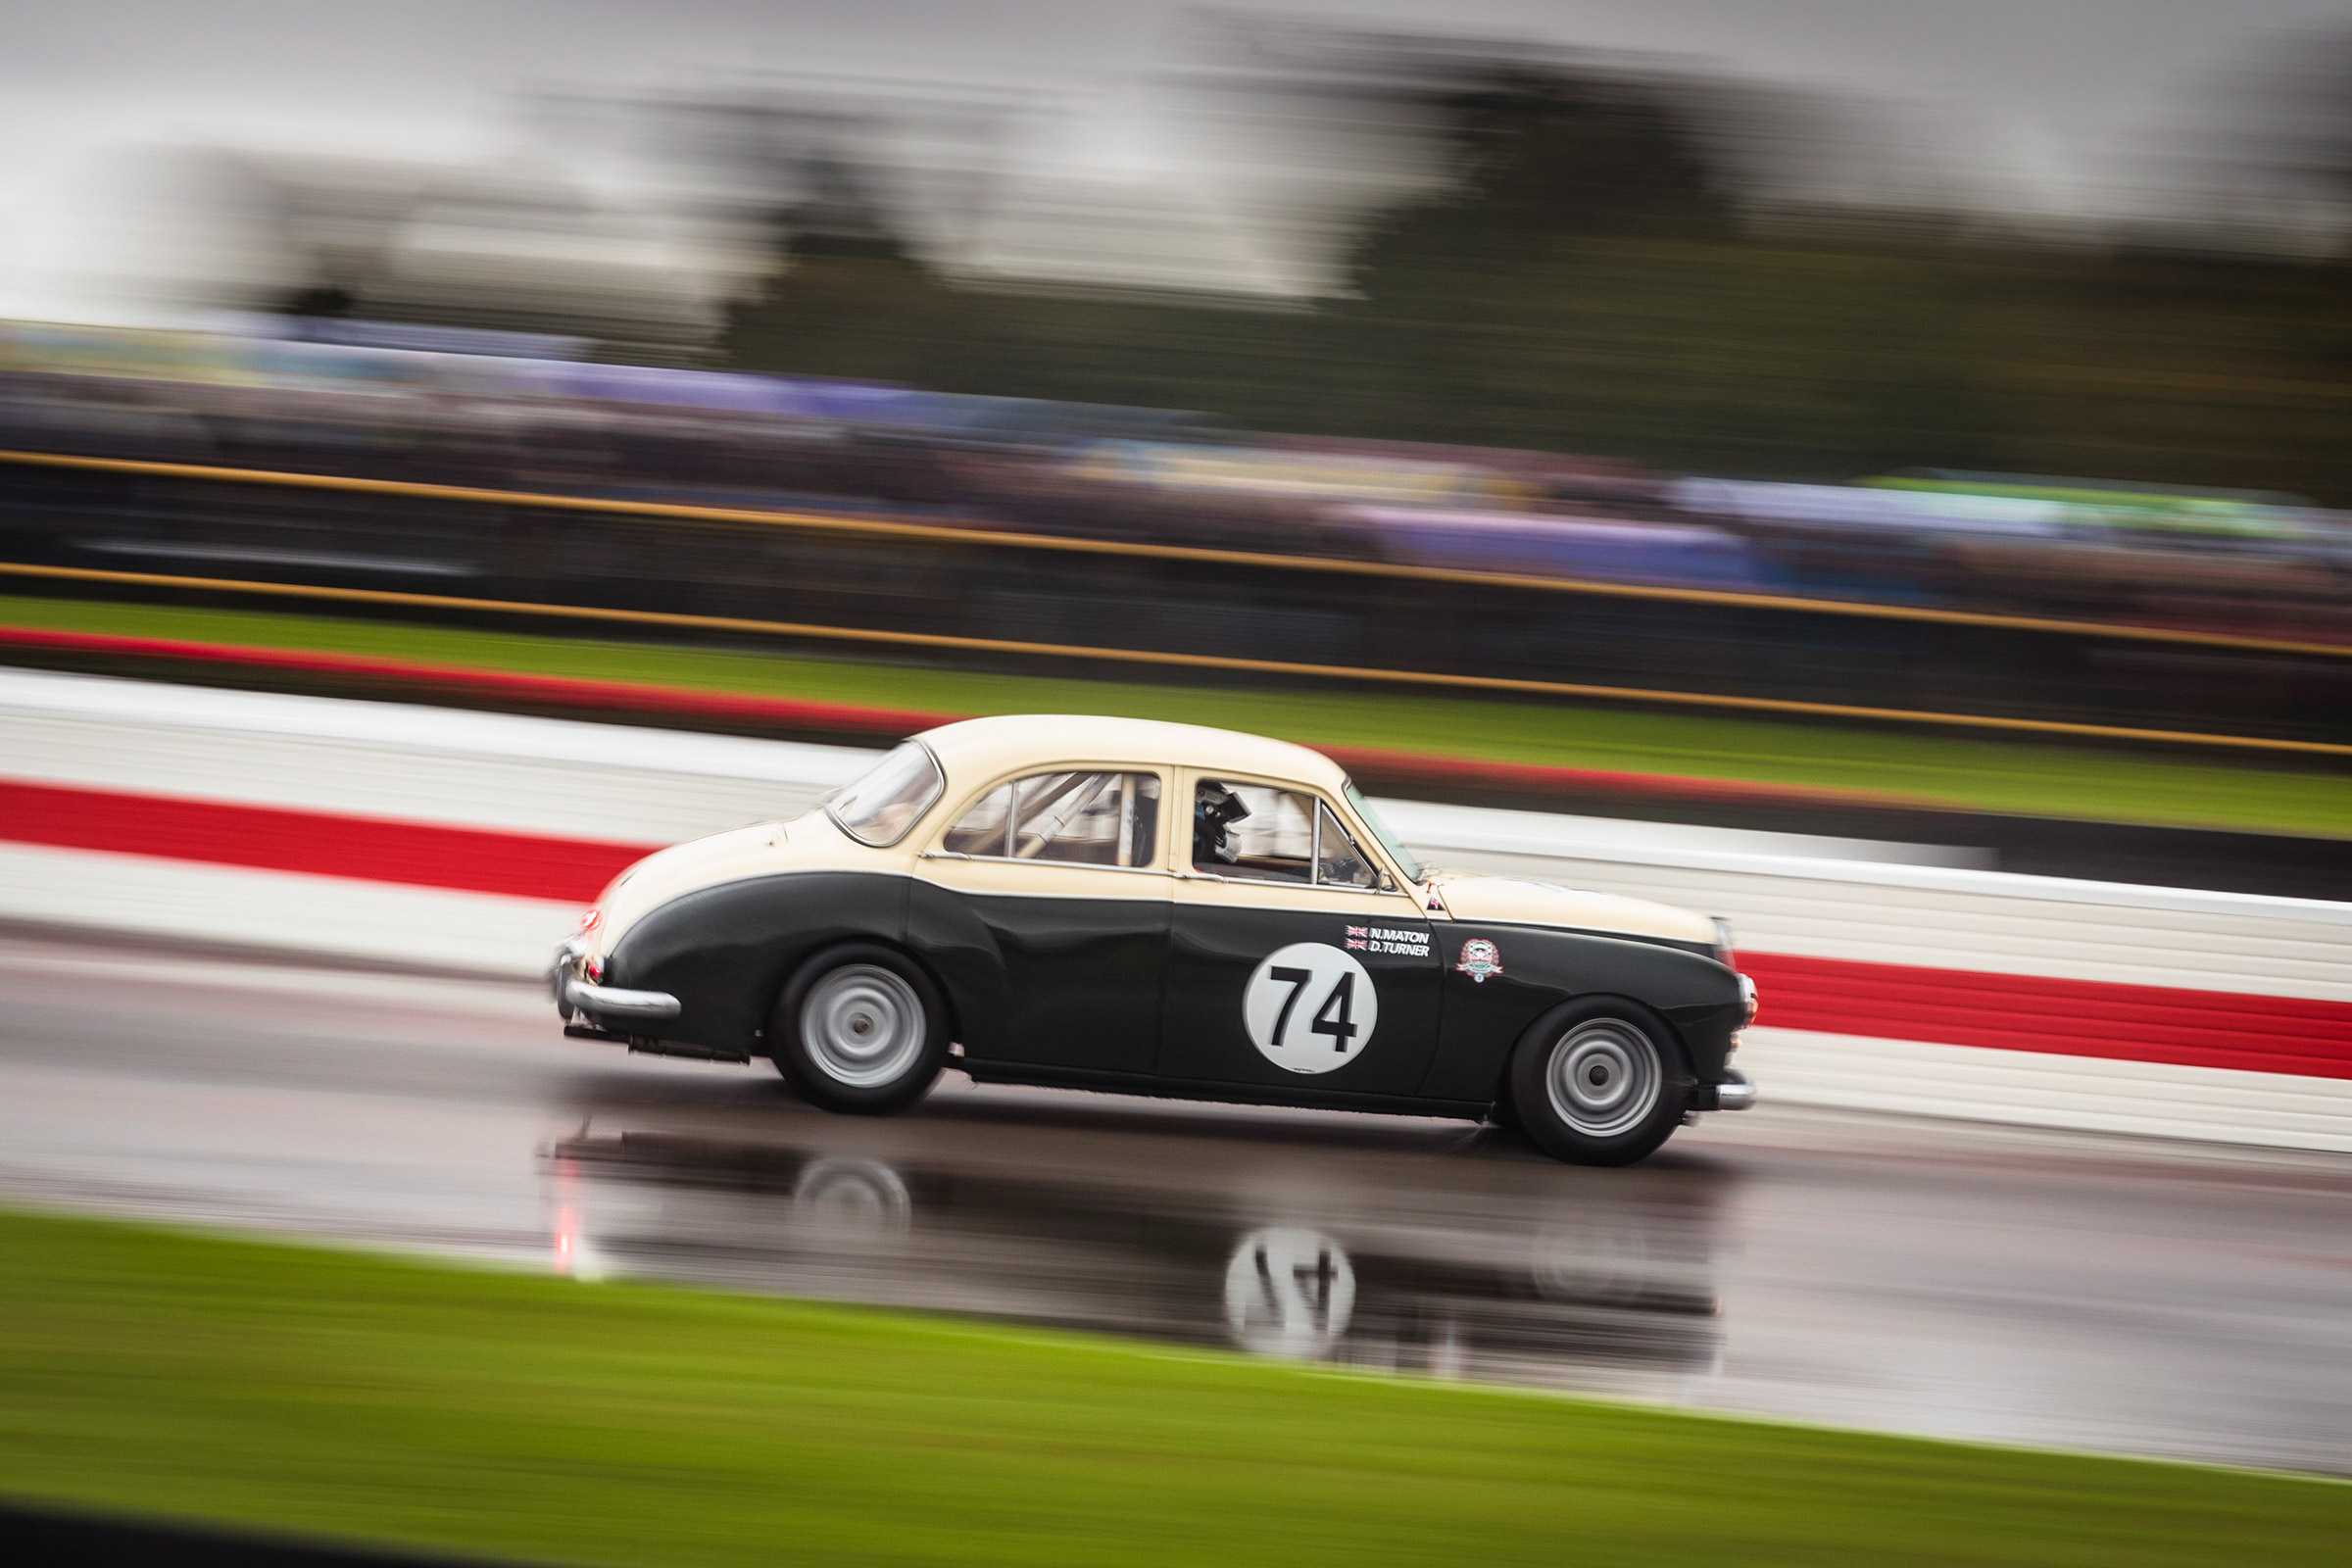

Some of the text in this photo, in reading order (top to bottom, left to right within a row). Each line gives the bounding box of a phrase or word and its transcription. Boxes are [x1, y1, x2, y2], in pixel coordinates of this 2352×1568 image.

[1369, 927, 1430, 944] N.MATON
[1368, 940, 1430, 957] D.TURNER
[1269, 965, 1358, 1054] 74
